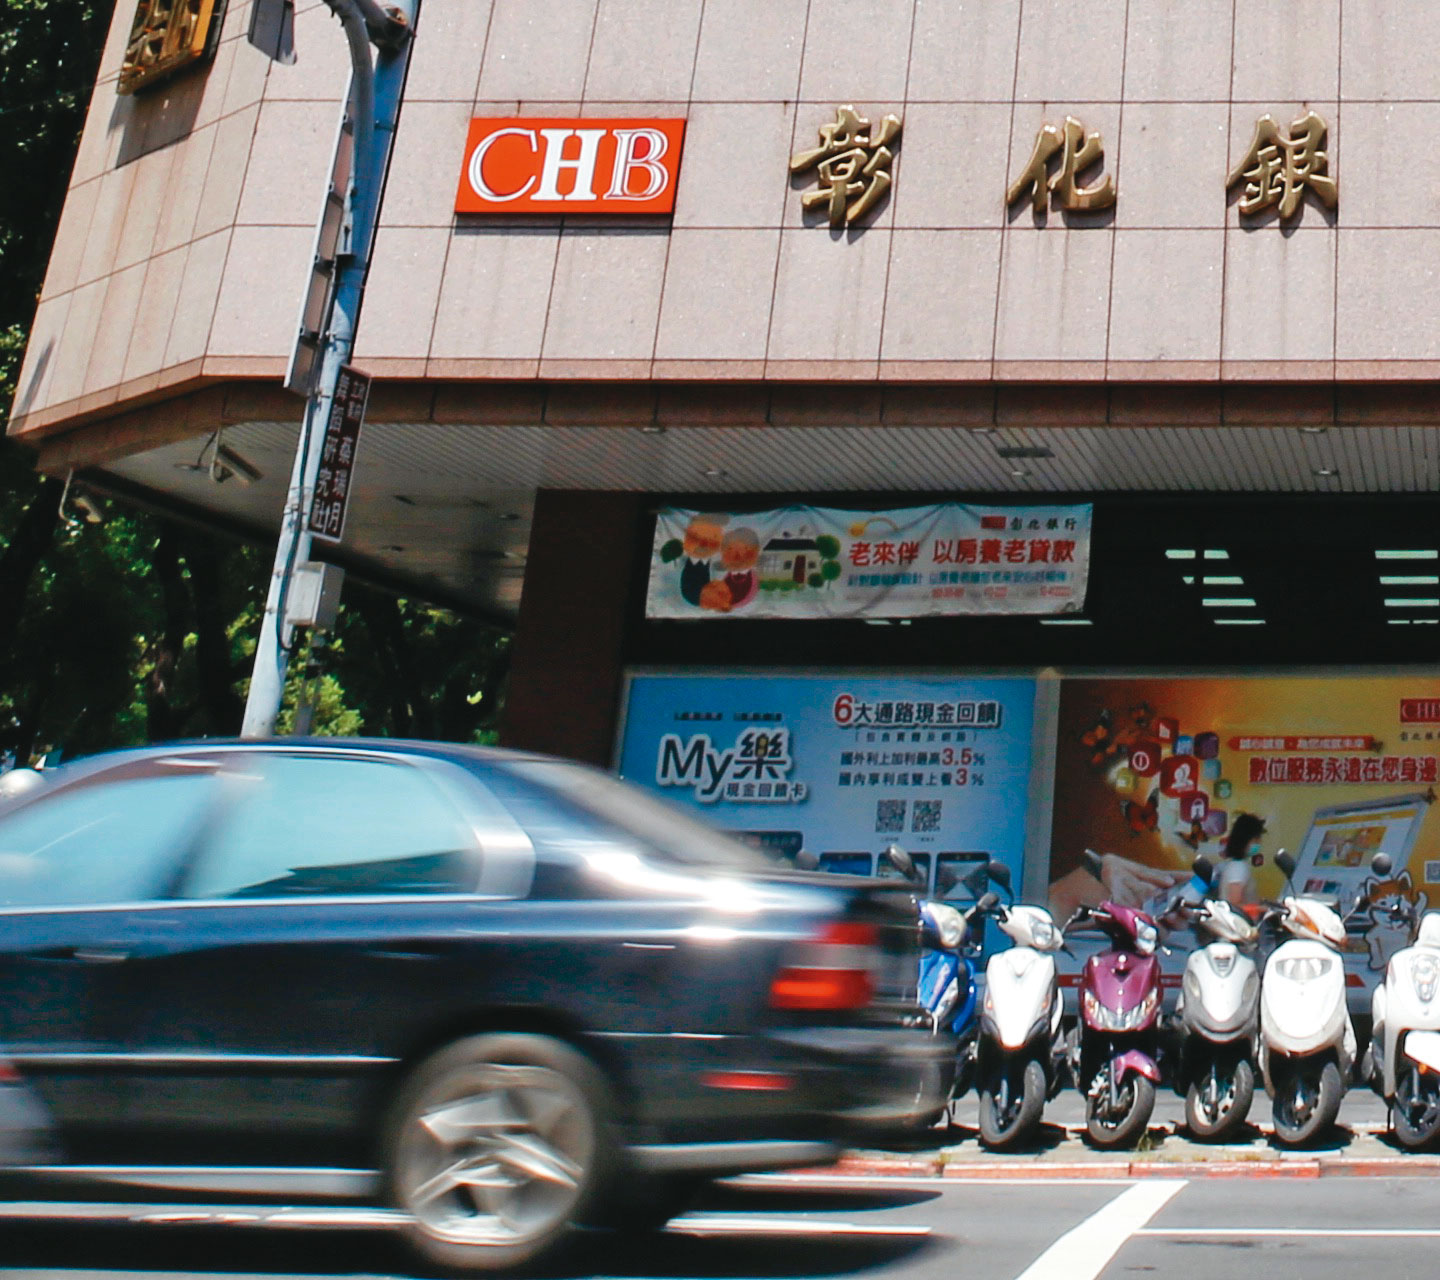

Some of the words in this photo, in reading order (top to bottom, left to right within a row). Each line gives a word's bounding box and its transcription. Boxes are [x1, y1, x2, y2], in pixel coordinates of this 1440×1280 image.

[468, 127, 669, 202] CHB
[848, 540, 920, 567] 老來伴
[833, 694, 998, 725] 6大通路現金回饋
[661, 731, 787, 795] My樂
